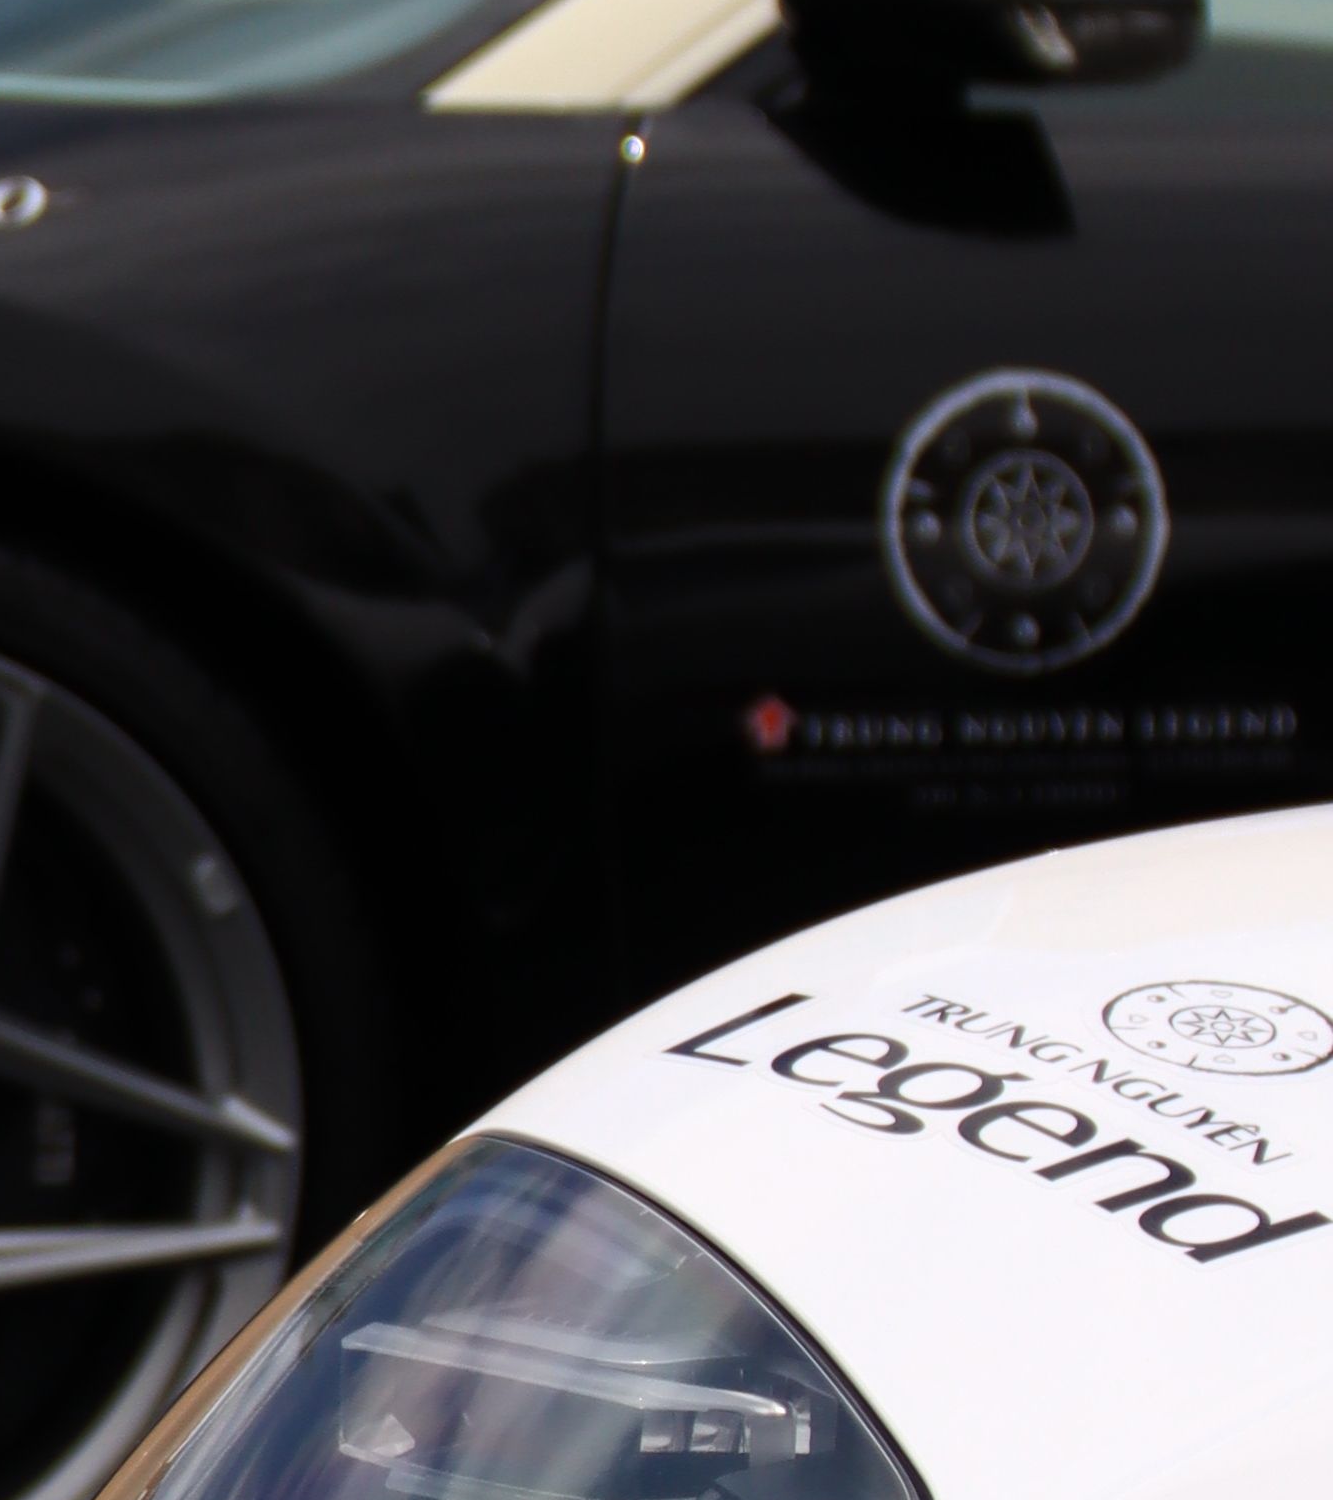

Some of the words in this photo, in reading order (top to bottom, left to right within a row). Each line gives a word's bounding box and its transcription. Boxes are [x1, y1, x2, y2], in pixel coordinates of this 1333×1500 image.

[661, 991, 1333, 1264] Legend
[899, 994, 1083, 1066] TRUNG
[1070, 1057, 1294, 1167] NGUYÊN
